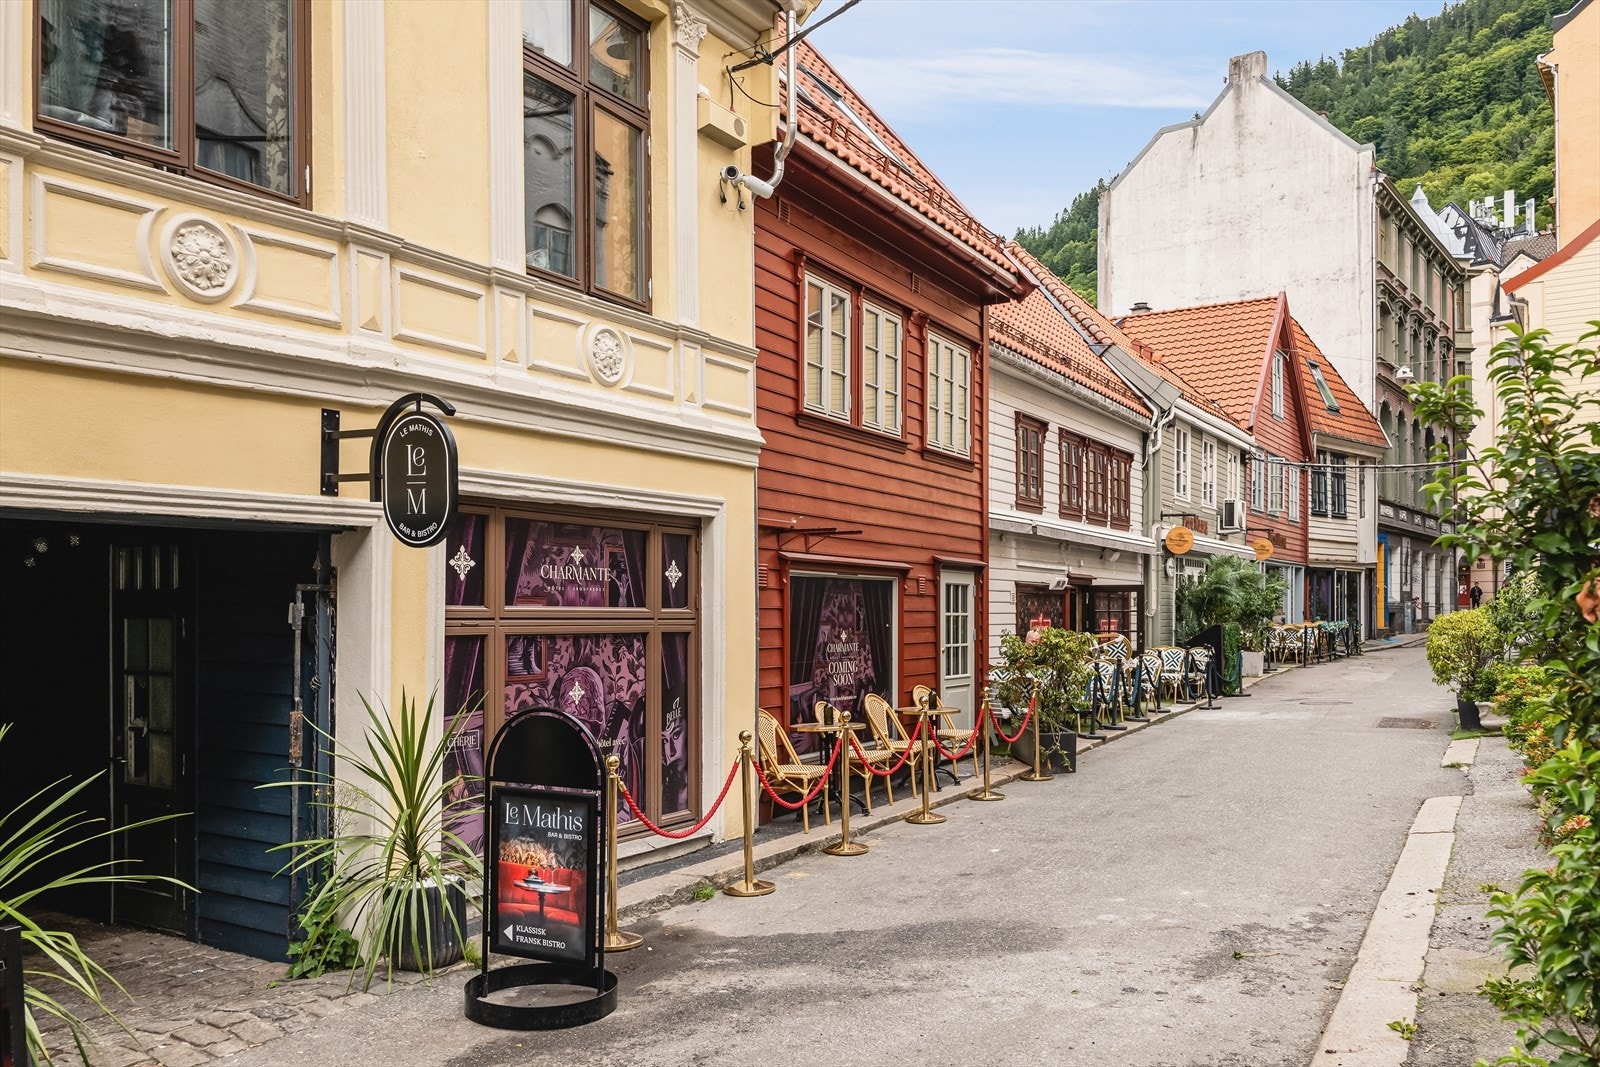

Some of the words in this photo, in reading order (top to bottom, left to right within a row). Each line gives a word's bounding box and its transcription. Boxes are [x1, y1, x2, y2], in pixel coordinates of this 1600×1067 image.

[400, 428, 408, 437] LE
[409, 424, 434, 436] MATHIS
[406, 444, 426, 476] Le
[406, 488, 426, 514] M
[398, 522, 411, 535] BAR
[418, 522, 438, 538] BISTRO
[540, 564, 611, 585] CHARMANTE
[826, 642, 859, 654] CHARMANTE
[828, 660, 858, 674] COMING
[833, 673, 854, 686] SOON
[506, 802, 518, 824] Le
[522, 804, 582, 832] Mathis
[516, 925, 546, 936] KLASSISK
[516, 936, 541, 946] FRANSK
[542, 939, 566, 949] BISTRO
